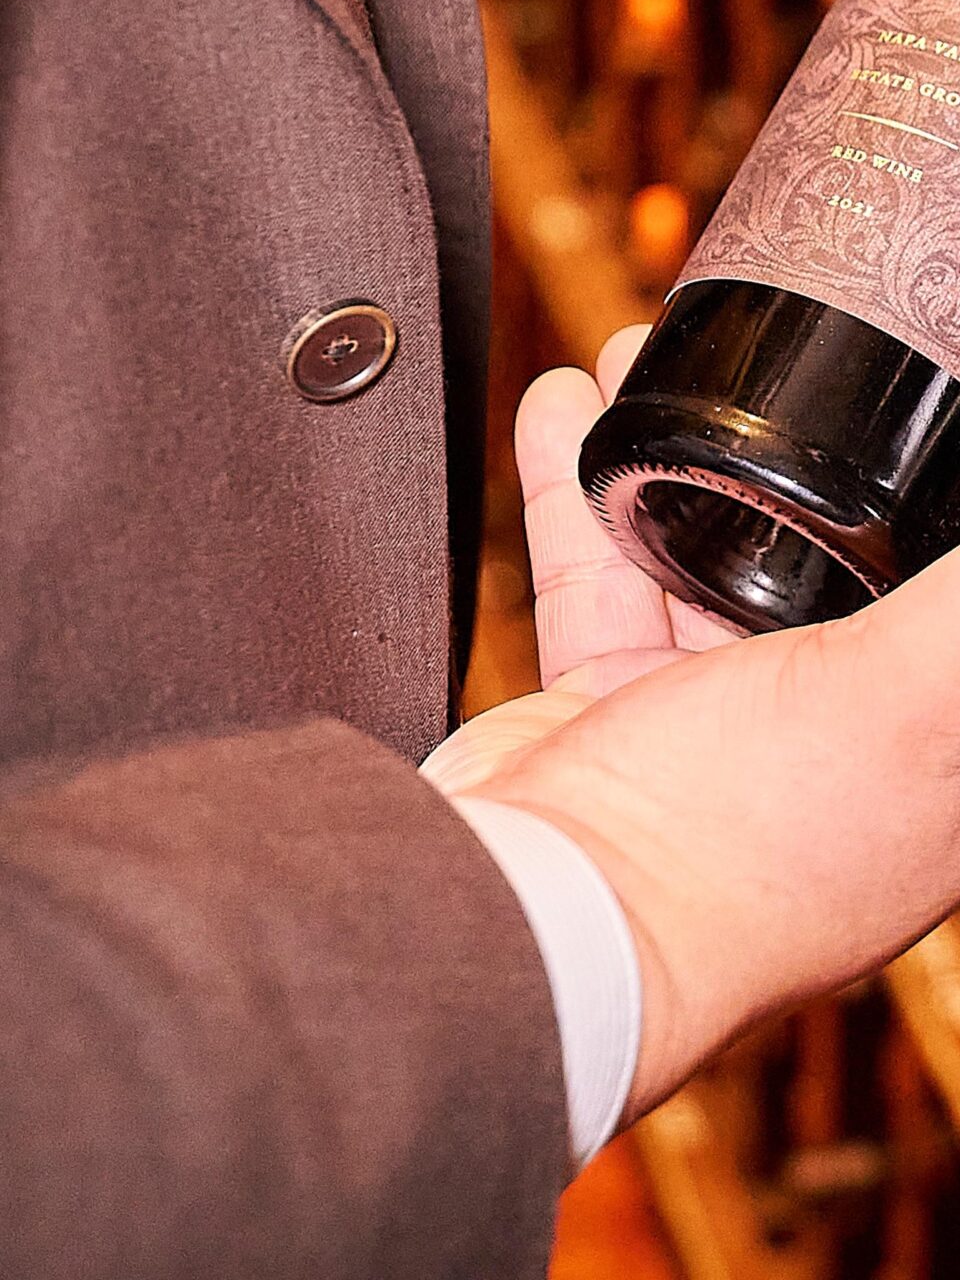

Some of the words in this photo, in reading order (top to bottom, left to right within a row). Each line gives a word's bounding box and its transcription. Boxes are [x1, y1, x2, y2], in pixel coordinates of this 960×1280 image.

[879, 31, 926, 51] NAPA
[850, 69, 914, 91] ESTATE
[831, 145, 867, 163] RED
[872, 155, 924, 184] WINE
[828, 195, 875, 218] 2021
